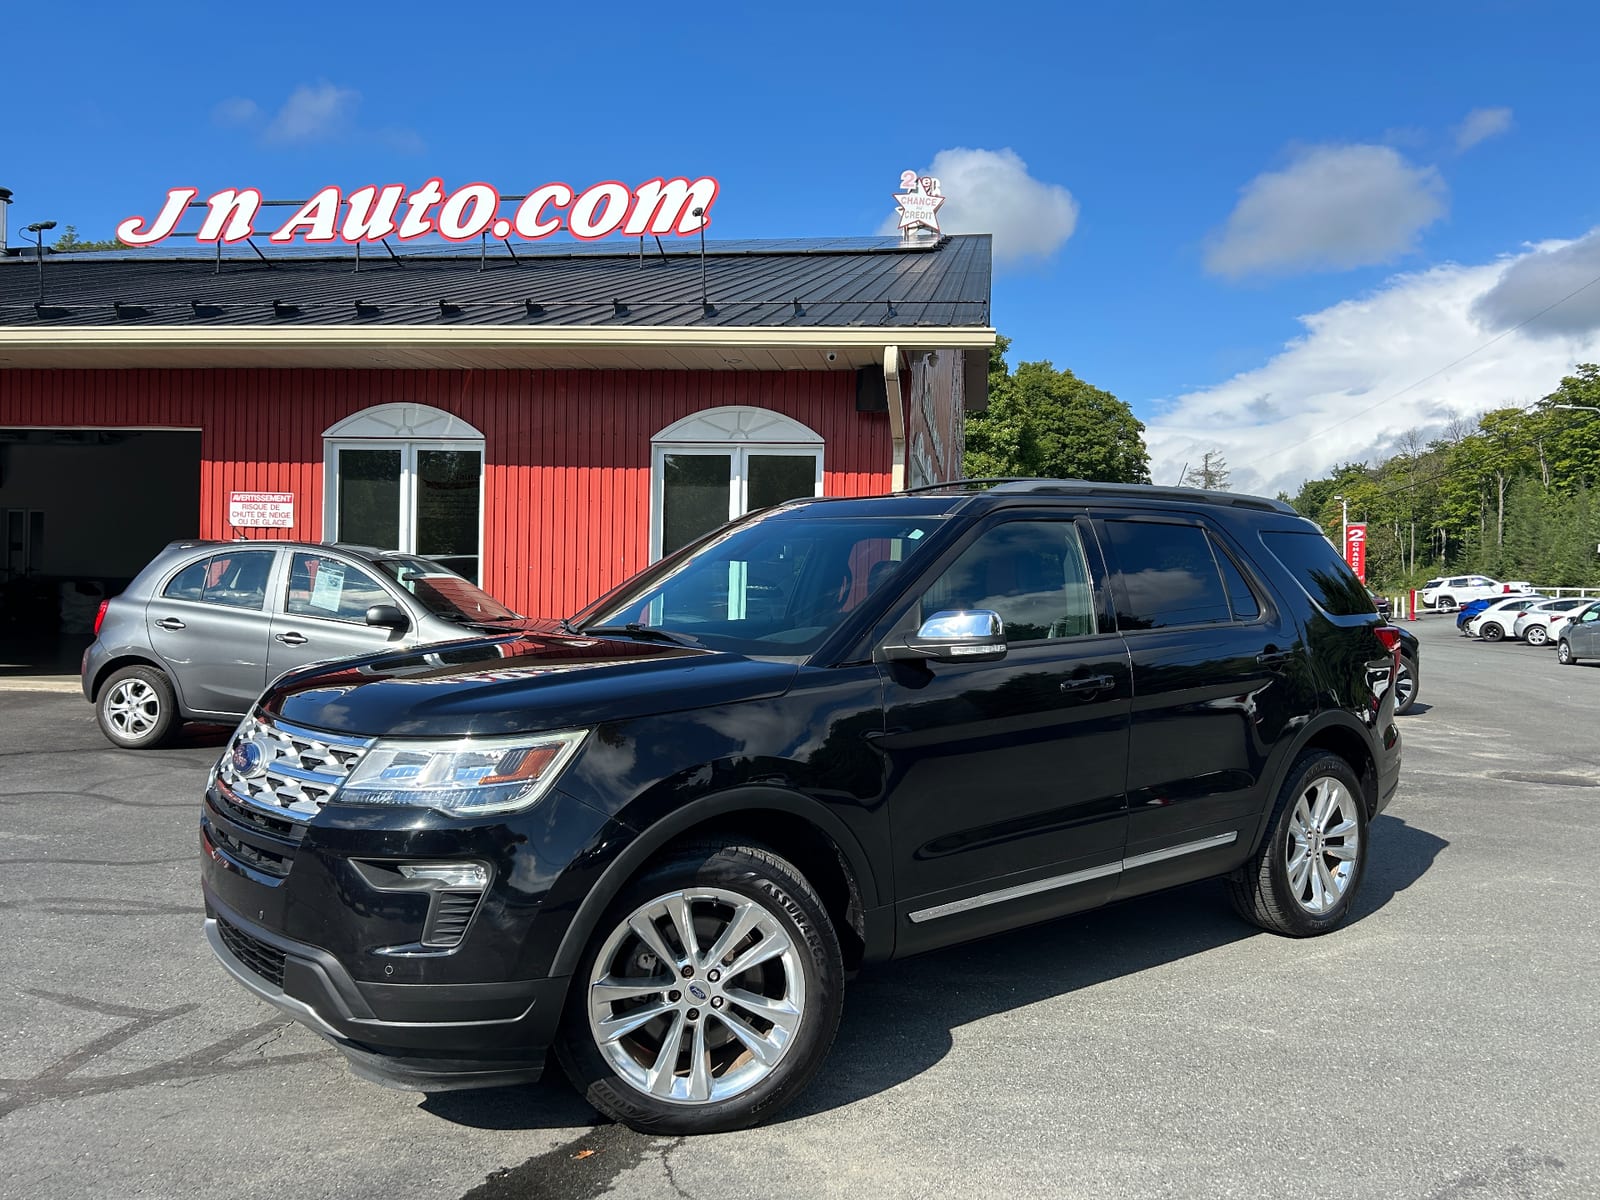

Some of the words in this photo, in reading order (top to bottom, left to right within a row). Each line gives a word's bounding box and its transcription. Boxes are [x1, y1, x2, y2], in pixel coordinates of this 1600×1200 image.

[901, 196, 937, 206] CHANCE
[271, 176, 720, 242] Auto.com
[232, 494, 292, 502] AVERTISSEMENT
[241, 503, 268, 511] RISQUE
[1348, 529, 1364, 542] 2
